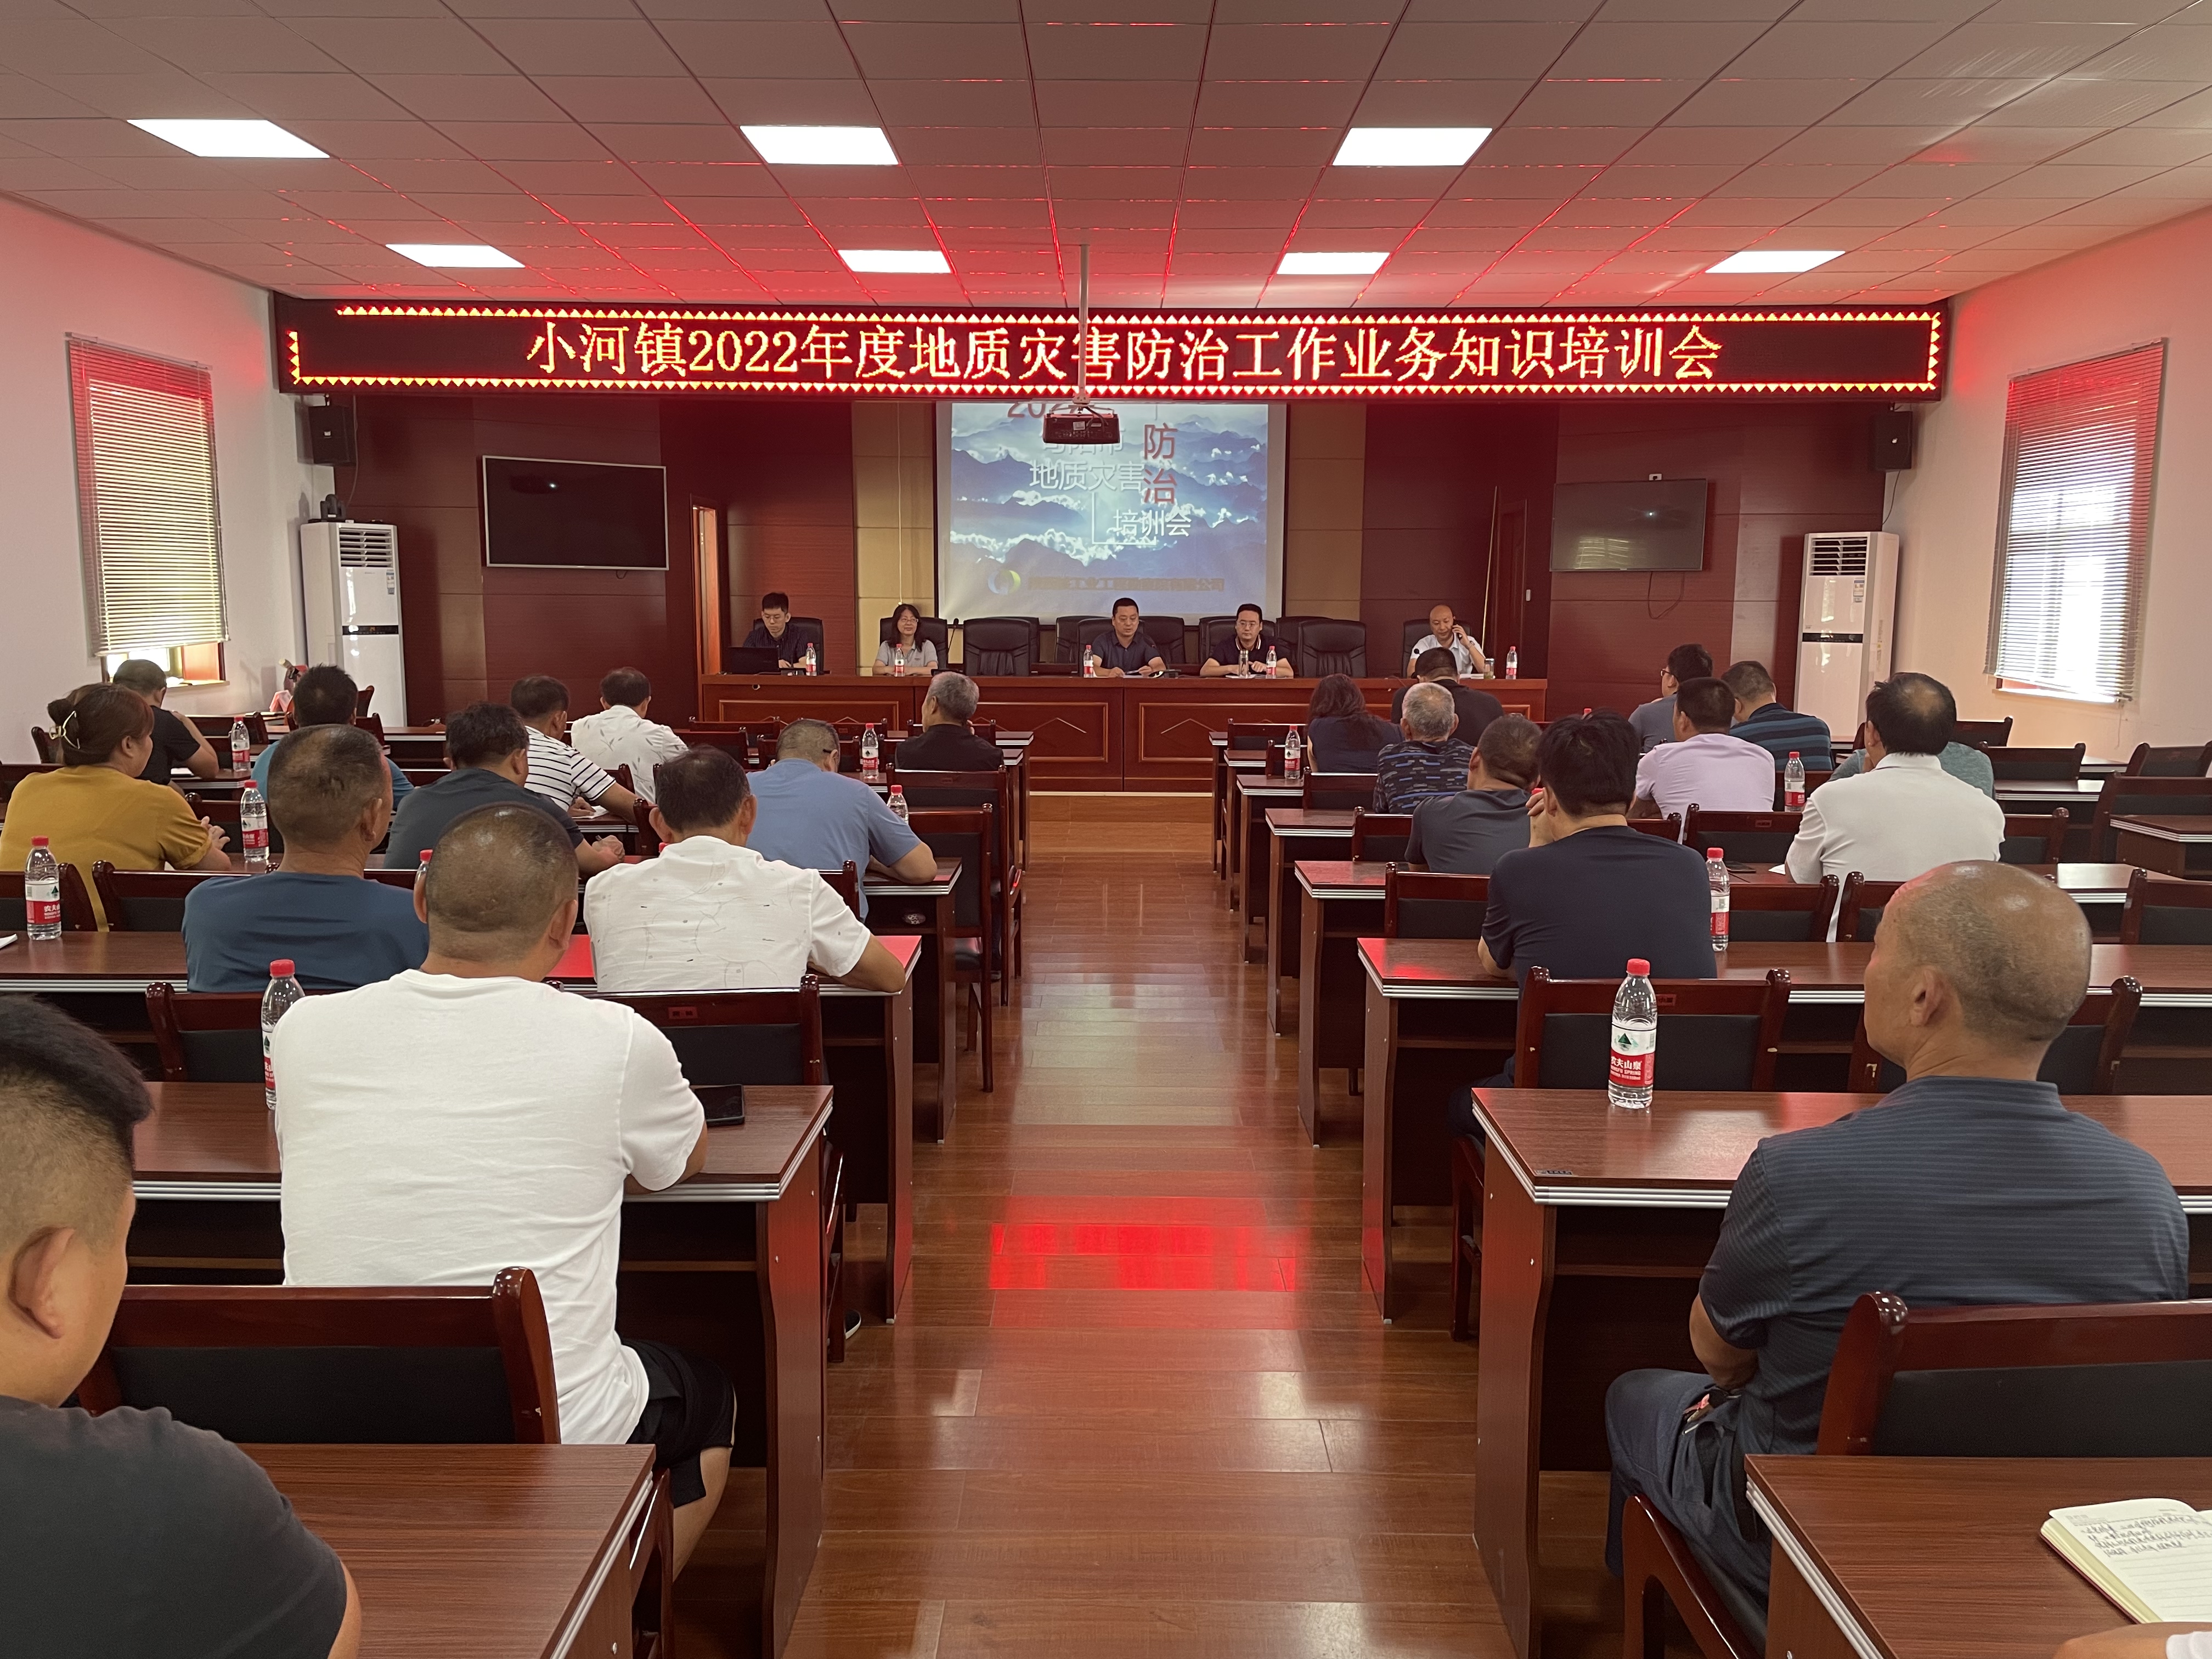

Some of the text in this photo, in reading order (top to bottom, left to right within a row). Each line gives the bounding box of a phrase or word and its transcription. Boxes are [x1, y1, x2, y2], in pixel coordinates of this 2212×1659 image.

[526, 321, 1723, 381] 小河镇2022年度地质灾害防治工作业务知识培训会
[1029, 460, 1144, 492] 地质灾害
[1143, 423, 1178, 505] 防治
[1113, 509, 1192, 538] 培训会
